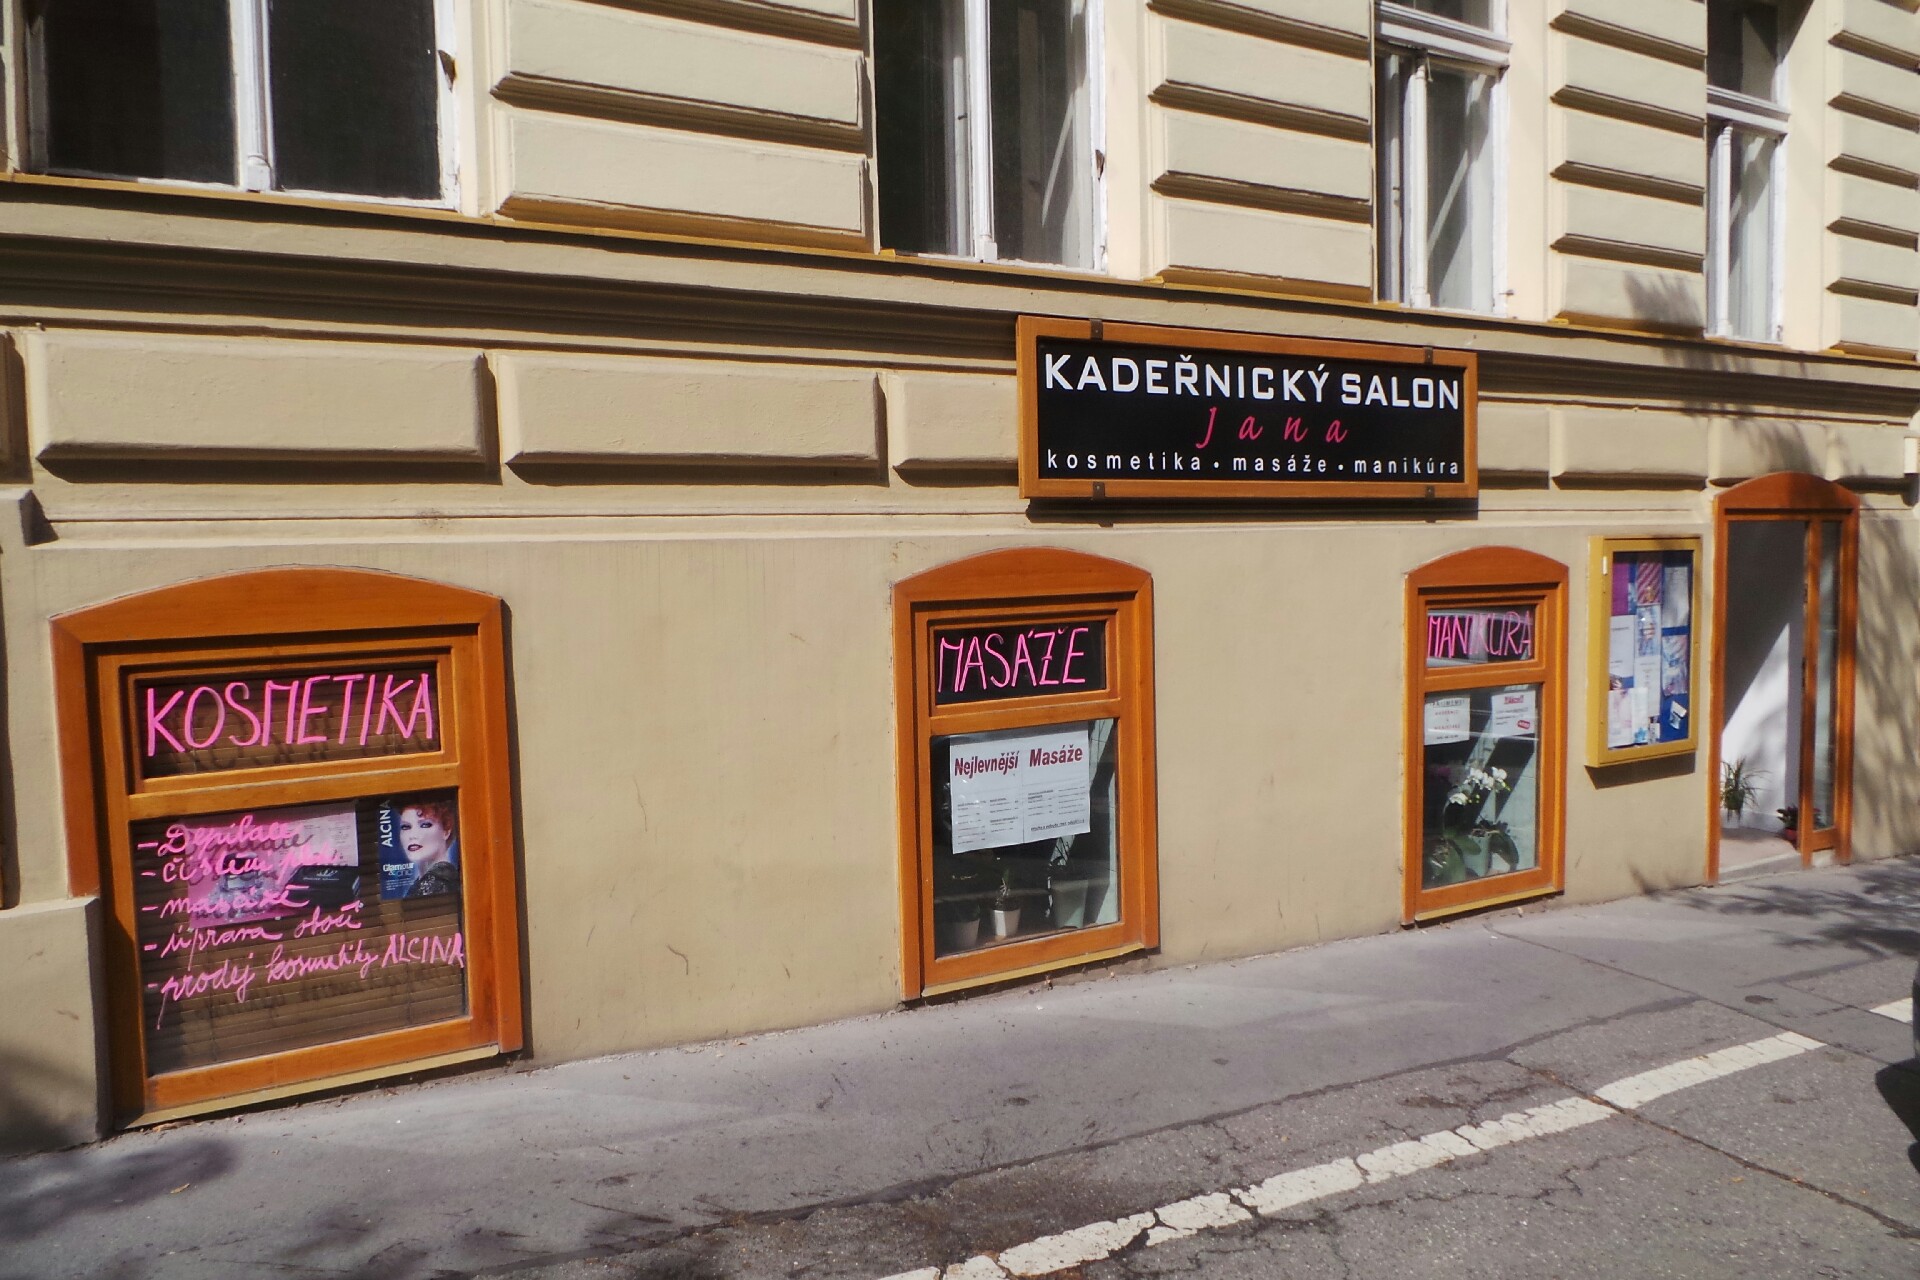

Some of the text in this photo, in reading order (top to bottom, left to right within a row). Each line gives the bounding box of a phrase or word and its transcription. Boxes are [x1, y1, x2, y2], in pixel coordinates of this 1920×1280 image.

[1045, 353, 1460, 410] KADEŘNICKÝ SALON
[1047, 449, 1460, 475] kosmetika masáže manikúra
[937, 627, 1089, 693] MASÁŽE
[146, 672, 434, 757] KOSMETIKA
[954, 743, 1083, 779] Nejlevnější Masáže
[380, 932, 465, 969] ALCINA
